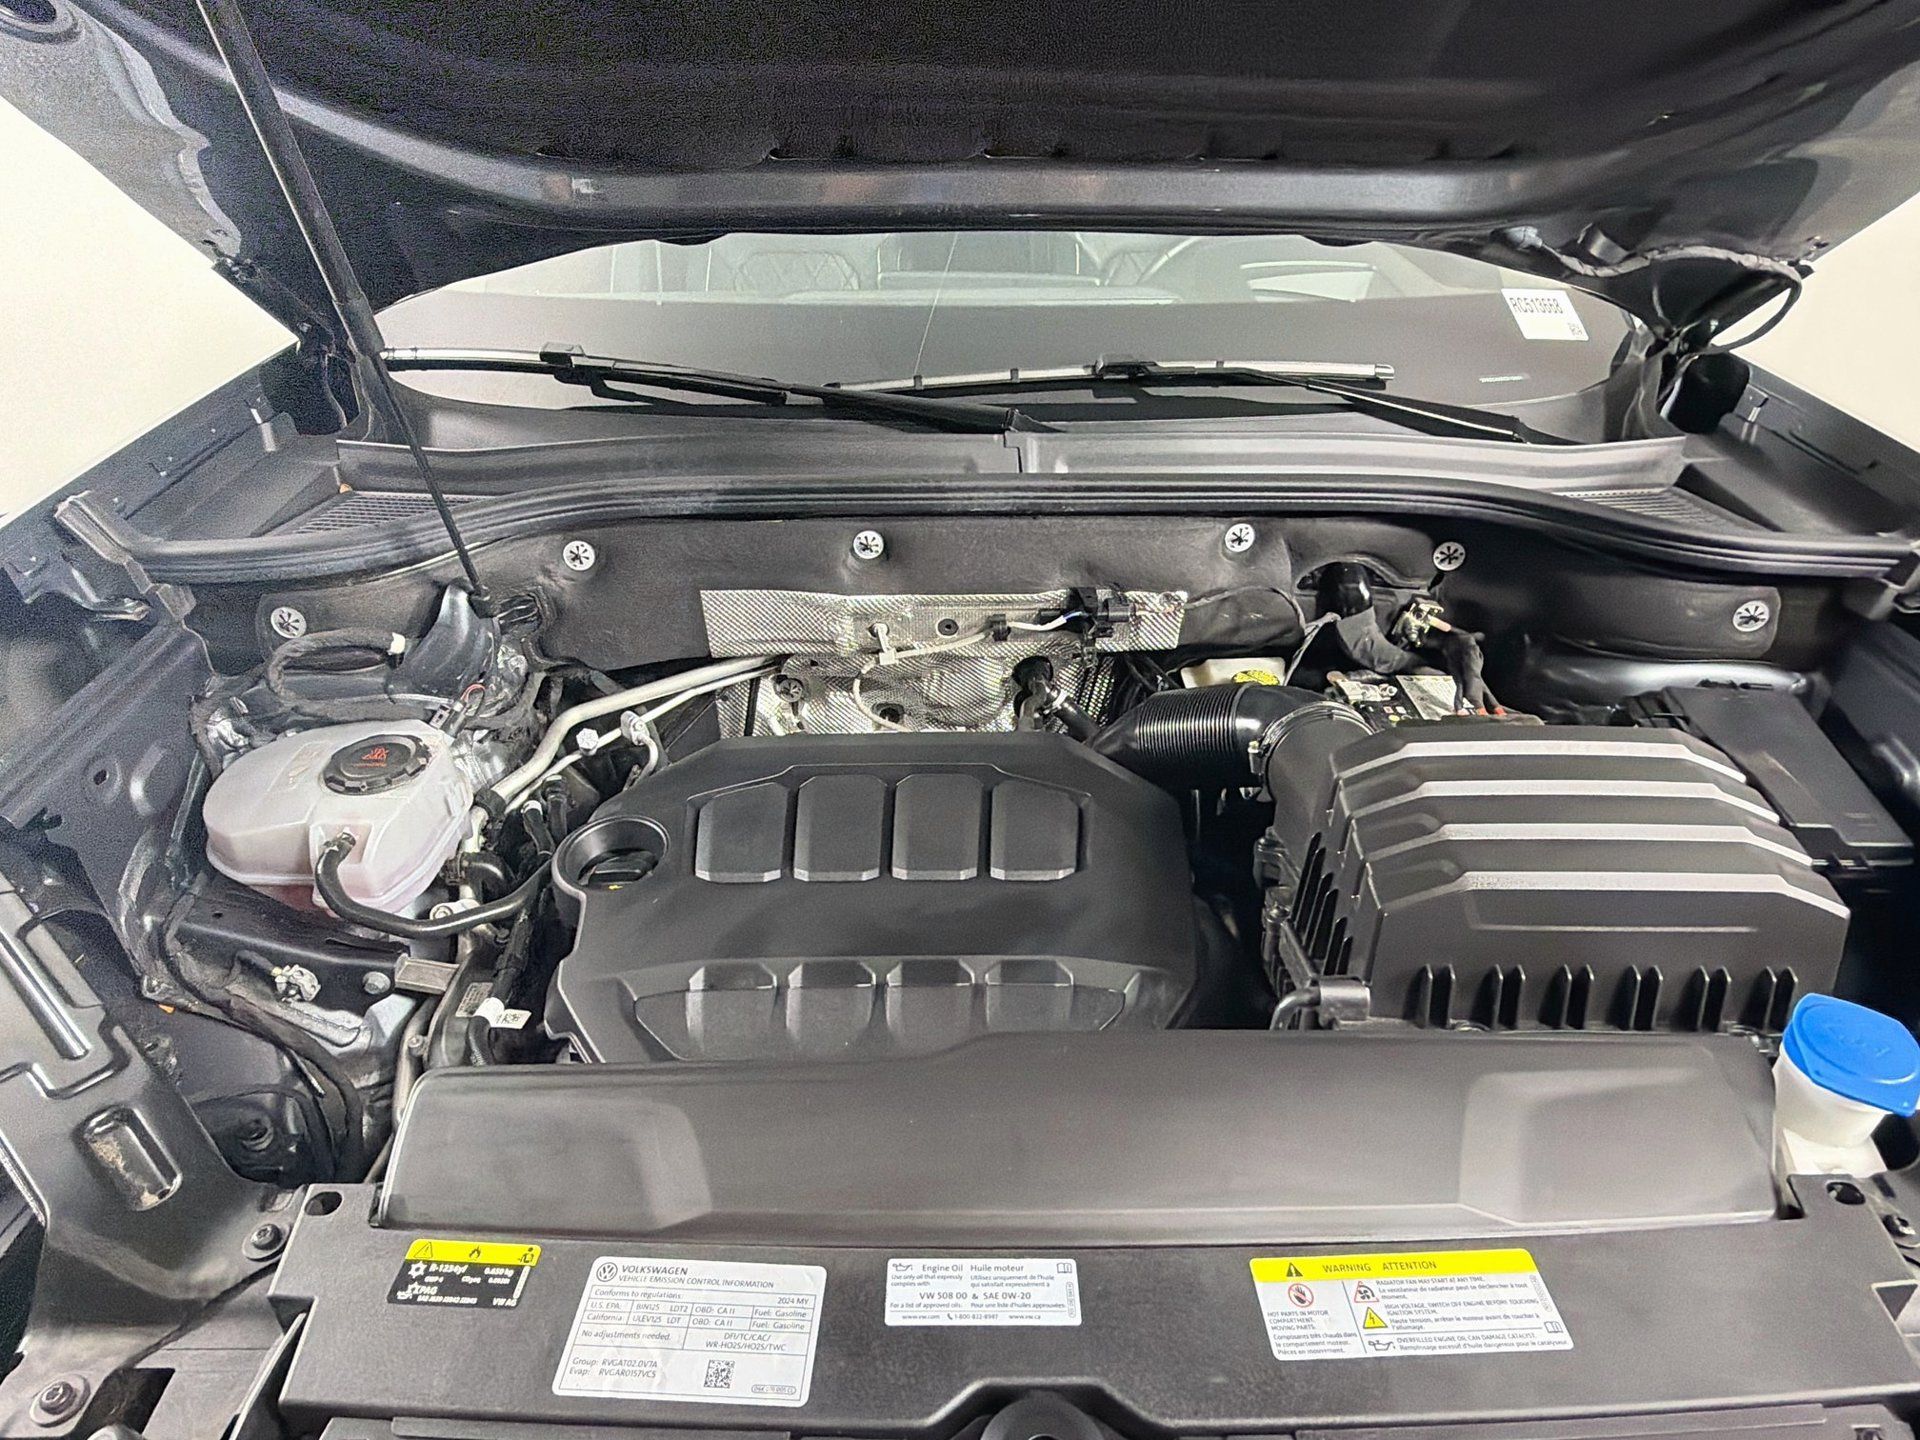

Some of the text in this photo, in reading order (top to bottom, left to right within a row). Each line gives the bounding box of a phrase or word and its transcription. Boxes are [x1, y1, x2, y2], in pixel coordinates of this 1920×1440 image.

[622, 1265, 688, 1275] VOLKSWAGEN
[922, 1264, 963, 1273] Engine Oil
[970, 1264, 1024, 1272] Huile moteur
[1322, 1261, 1437, 1273] WARNING ATTENTION
[649, 1276, 685, 1284] EMISSION
[687, 1278, 721, 1286] CONTROL
[722, 1279, 774, 1288] INFORMATION
[594, 1289, 630, 1297] Conforms
[631, 1290, 639, 1298] to
[919, 1292, 935, 1300] VW
[937, 1292, 954, 1300] 508
[955, 1292, 968, 1300] 00
[983, 1292, 1000, 1300] SAE
[1001, 1292, 1032, 1300] 0W-20
[777, 1297, 795, 1305] 2024
[636, 1303, 688, 1313] BIN125 LDT2
[694, 1306, 714, 1314] OBD:
[717, 1307, 728, 1315] CA
[754, 1308, 807, 1317] Fuel: Gasoline
[632, 1315, 681, 1324] ULEV125 LDT
[691, 1318, 711, 1326] OBD:
[714, 1319, 726, 1327] CA
[752, 1320, 805, 1330] Fuel: Gasoline
[581, 1329, 672, 1340] No adjustments needed.
[724, 1332, 772, 1342] DFI/TC/CAC/
[572, 1357, 599, 1367] Group:
[569, 1367, 591, 1376] Evap:
